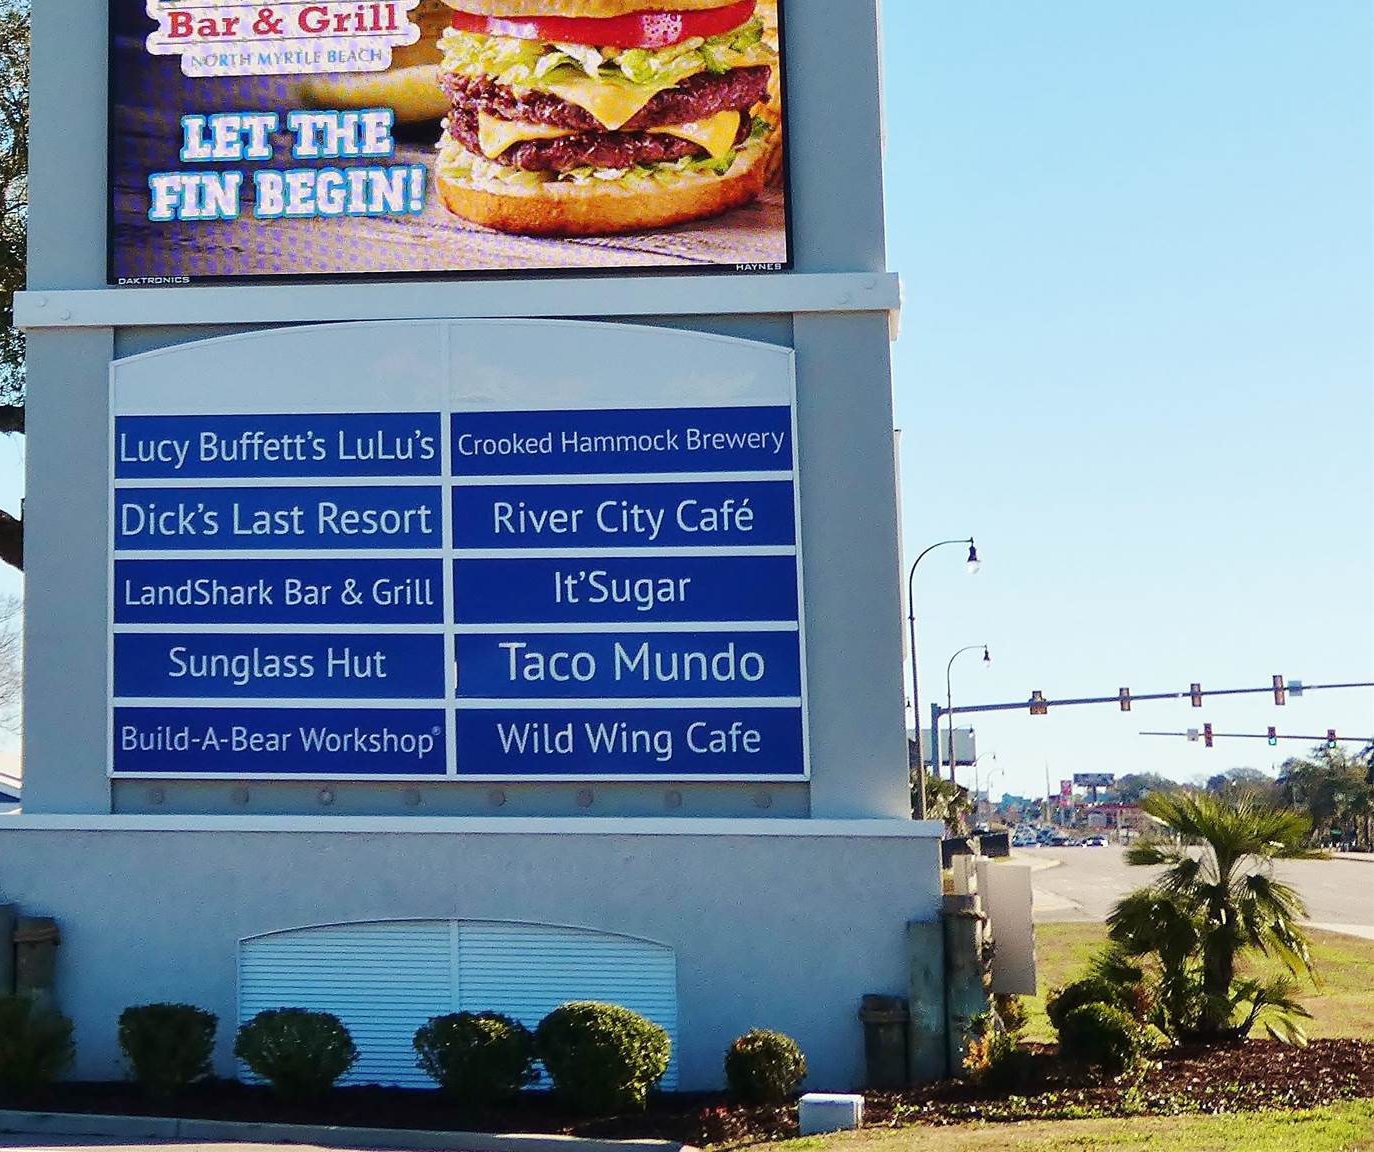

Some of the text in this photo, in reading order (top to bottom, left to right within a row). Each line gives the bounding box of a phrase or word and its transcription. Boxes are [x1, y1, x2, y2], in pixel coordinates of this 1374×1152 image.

[167, 3, 398, 39] Bar & Grill
[191, 47, 383, 69] NORTH MYRTLE BEACH
[180, 108, 394, 162] LET THE
[148, 163, 426, 221] FIN BEGIN!
[118, 276, 191, 285] DAKTRONICS
[736, 263, 782, 271] HAYNES
[120, 429, 435, 469] Lucy Buffett's LuLu's
[458, 428, 784, 455] Crooked Hammock Brewery
[121, 502, 432, 535] Dick's Last Resort
[493, 498, 755, 540] River City Café
[125, 578, 434, 606] LandShark Bar & Grill
[554, 570, 691, 611] It'Sugar
[168, 646, 387, 686] Sunglass Hut
[498, 641, 766, 682] Taco Mundo
[121, 726, 292, 752] Build-A-Bear
[496, 721, 761, 762] Wild Wing Cafe
